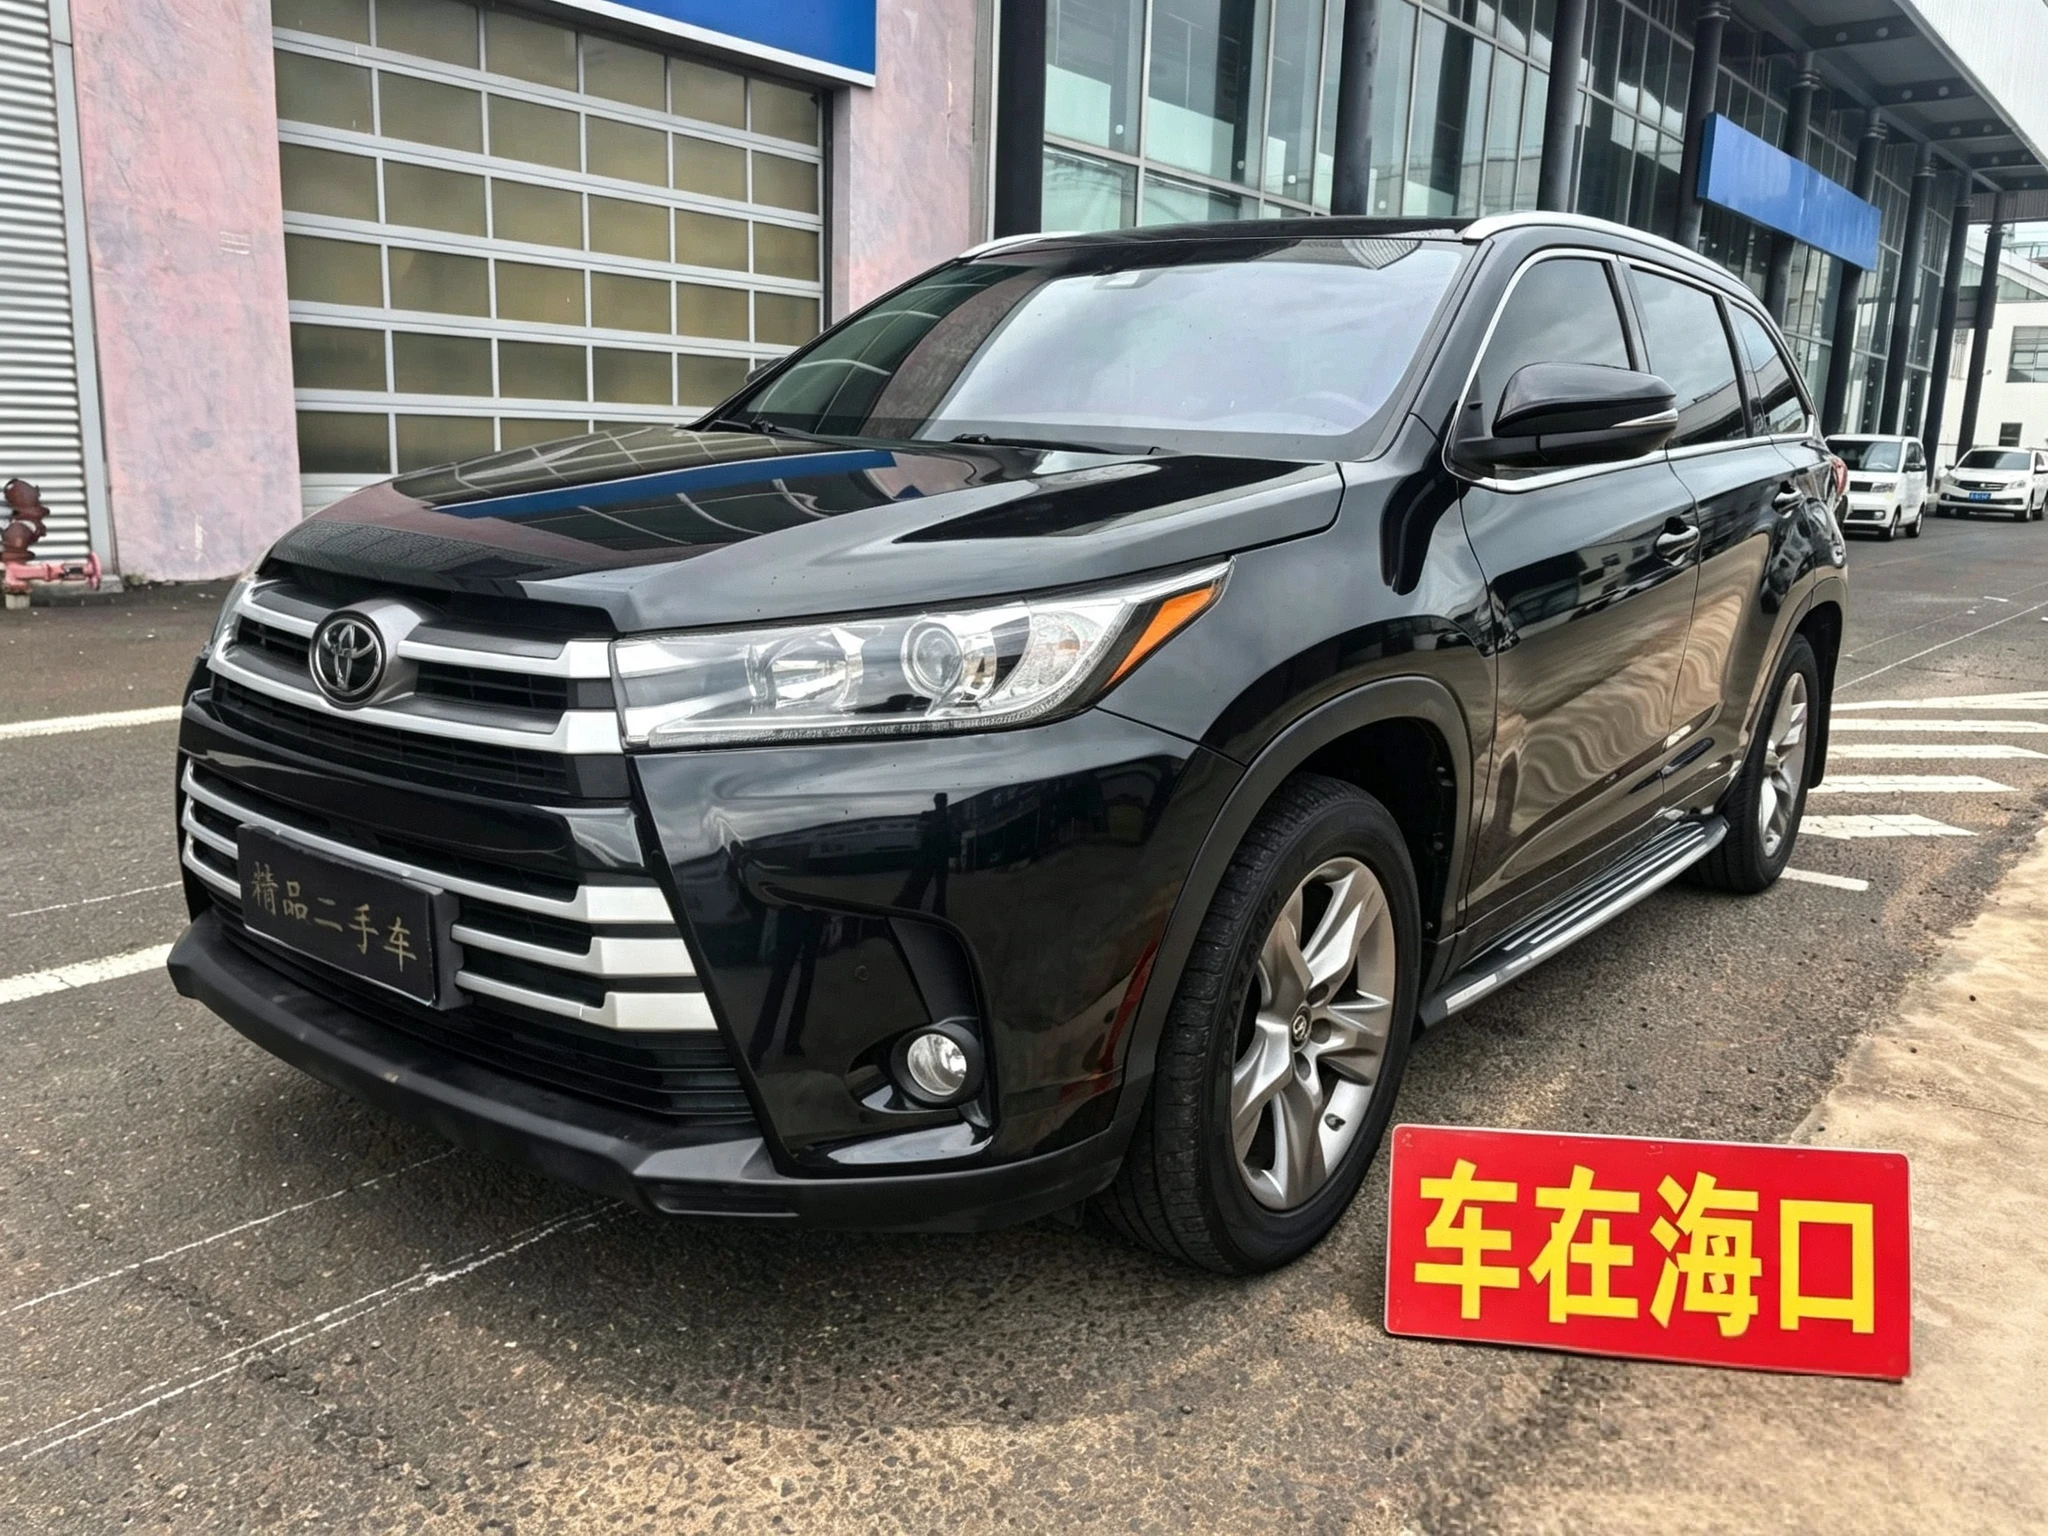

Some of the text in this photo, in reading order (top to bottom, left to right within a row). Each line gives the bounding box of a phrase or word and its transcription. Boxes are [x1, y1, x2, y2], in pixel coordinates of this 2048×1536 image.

[251, 861, 418, 973] 精品二手车
[1414, 1158, 1875, 1338] 车在海口
